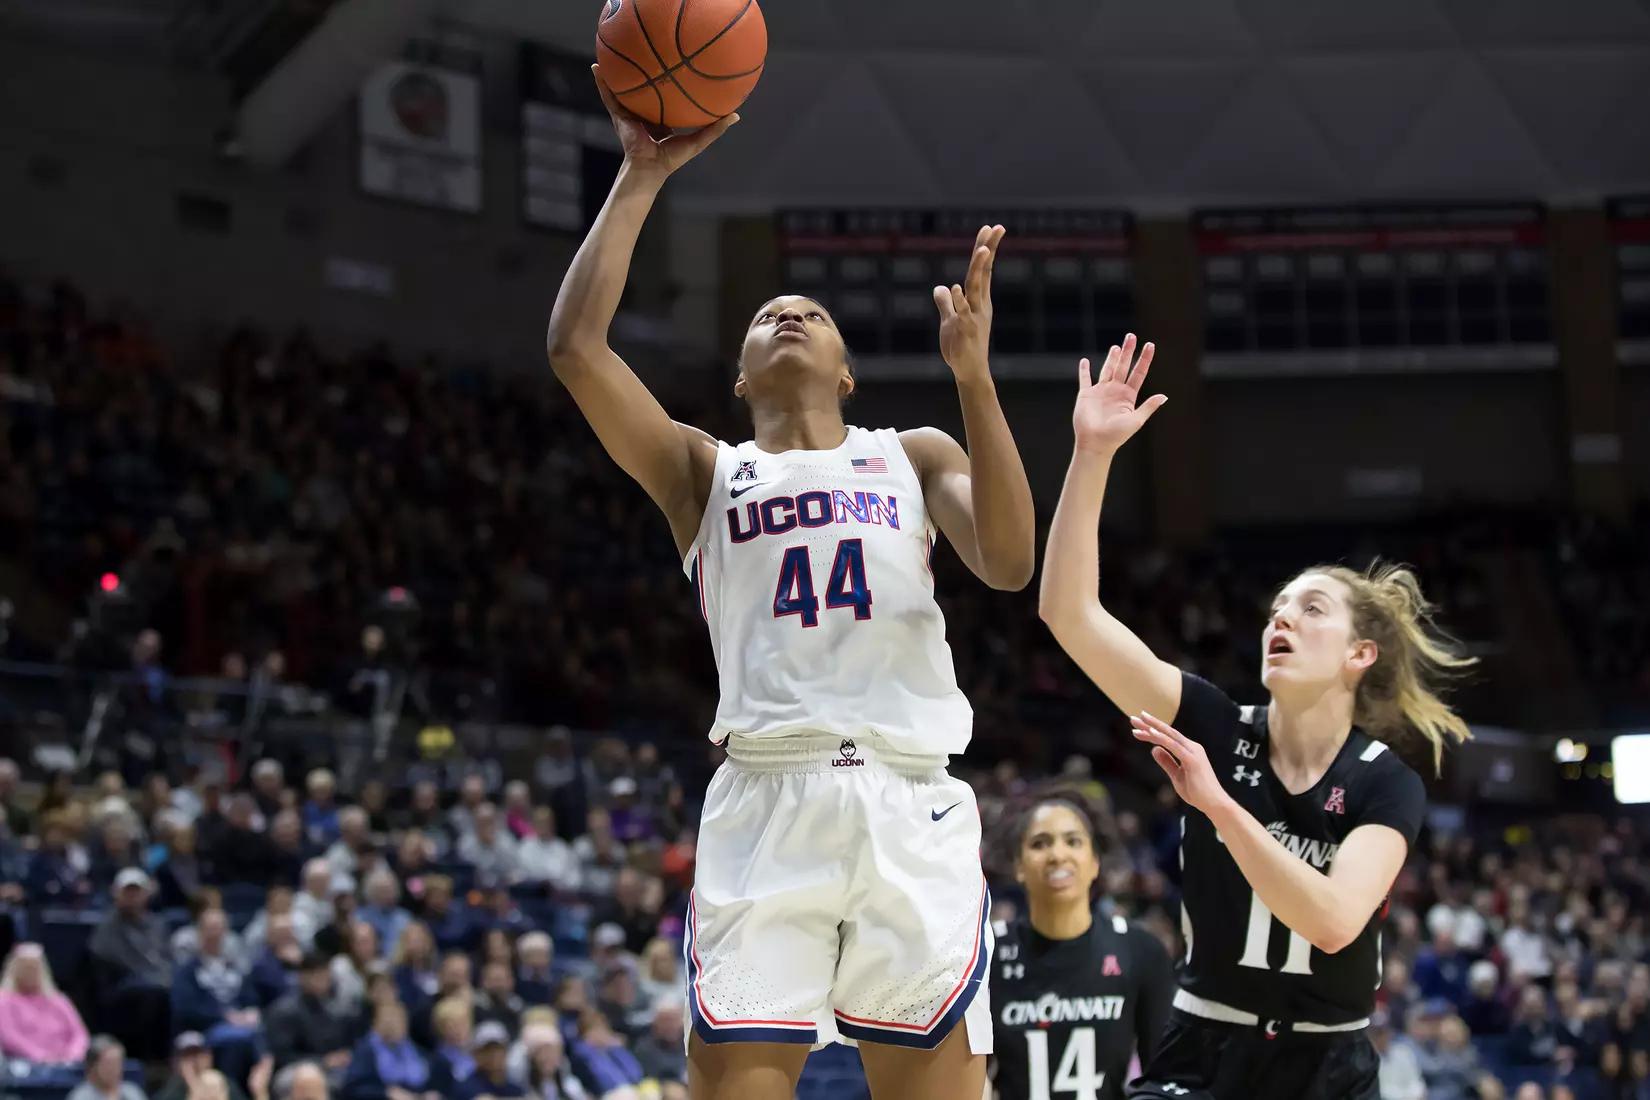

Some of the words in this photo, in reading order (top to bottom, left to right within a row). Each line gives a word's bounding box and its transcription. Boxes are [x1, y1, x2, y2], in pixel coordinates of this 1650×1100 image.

[727, 490, 900, 543] UCONN
[773, 538, 873, 628] 44
[831, 758, 865, 767] UCONN
[1234, 738, 1260, 760] RJ
[1001, 993, 1126, 1026] CINCINNATI
[1025, 1027, 1106, 1100] 14
